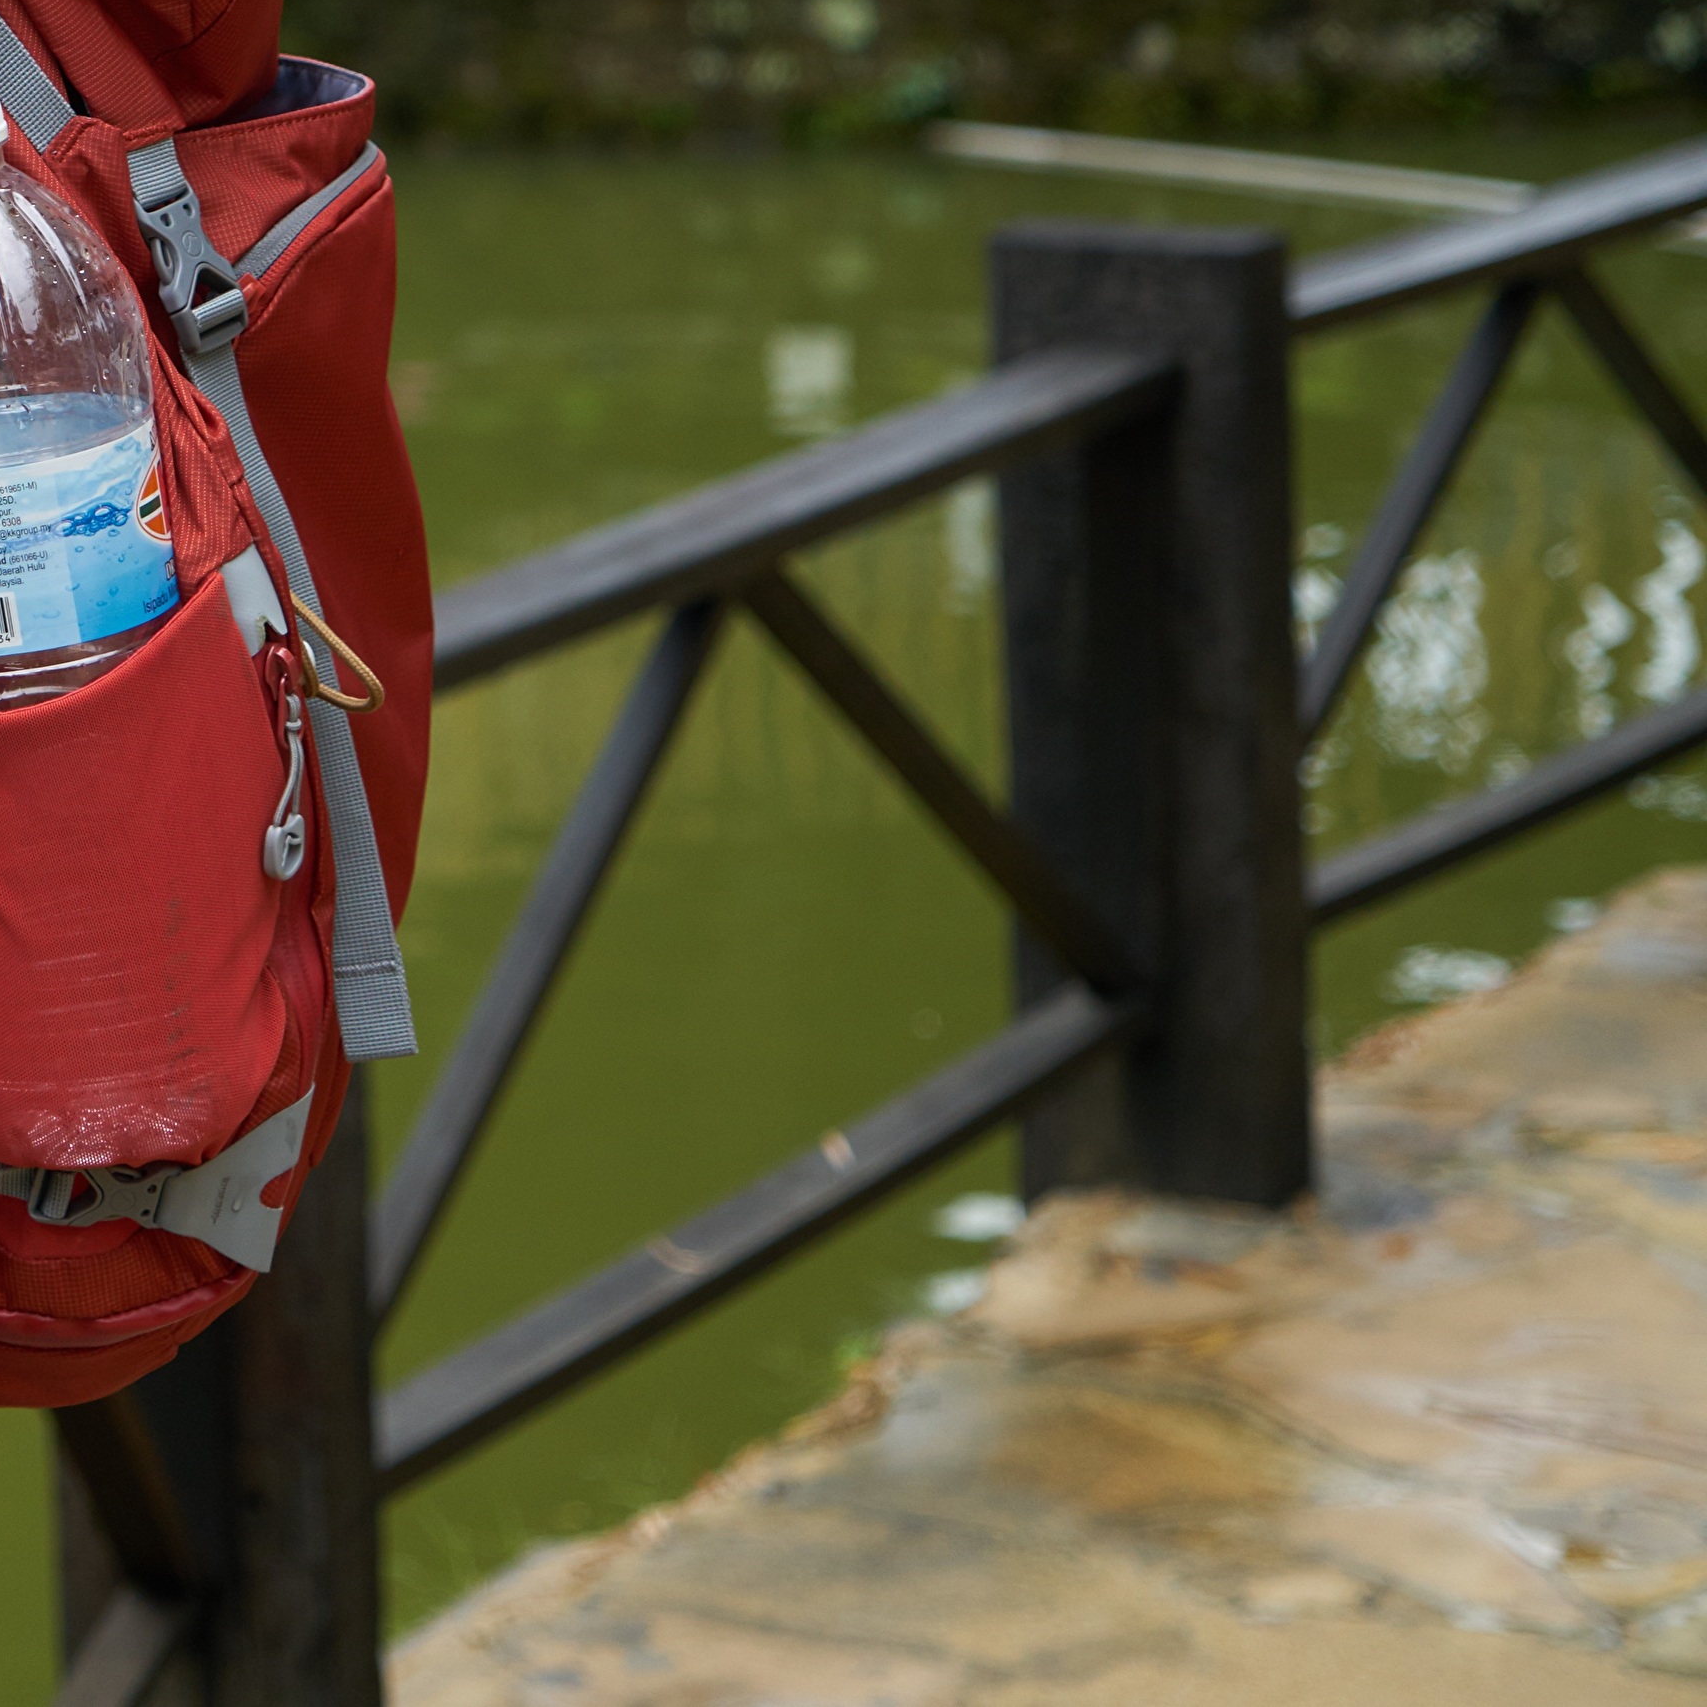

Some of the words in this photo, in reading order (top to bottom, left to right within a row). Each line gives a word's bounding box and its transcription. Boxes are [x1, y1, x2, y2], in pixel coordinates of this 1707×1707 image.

[2, 517, 22, 527] 6308
[9, 551, 48, 566] (661066-U)
[28, 562, 46, 572] Hulu
